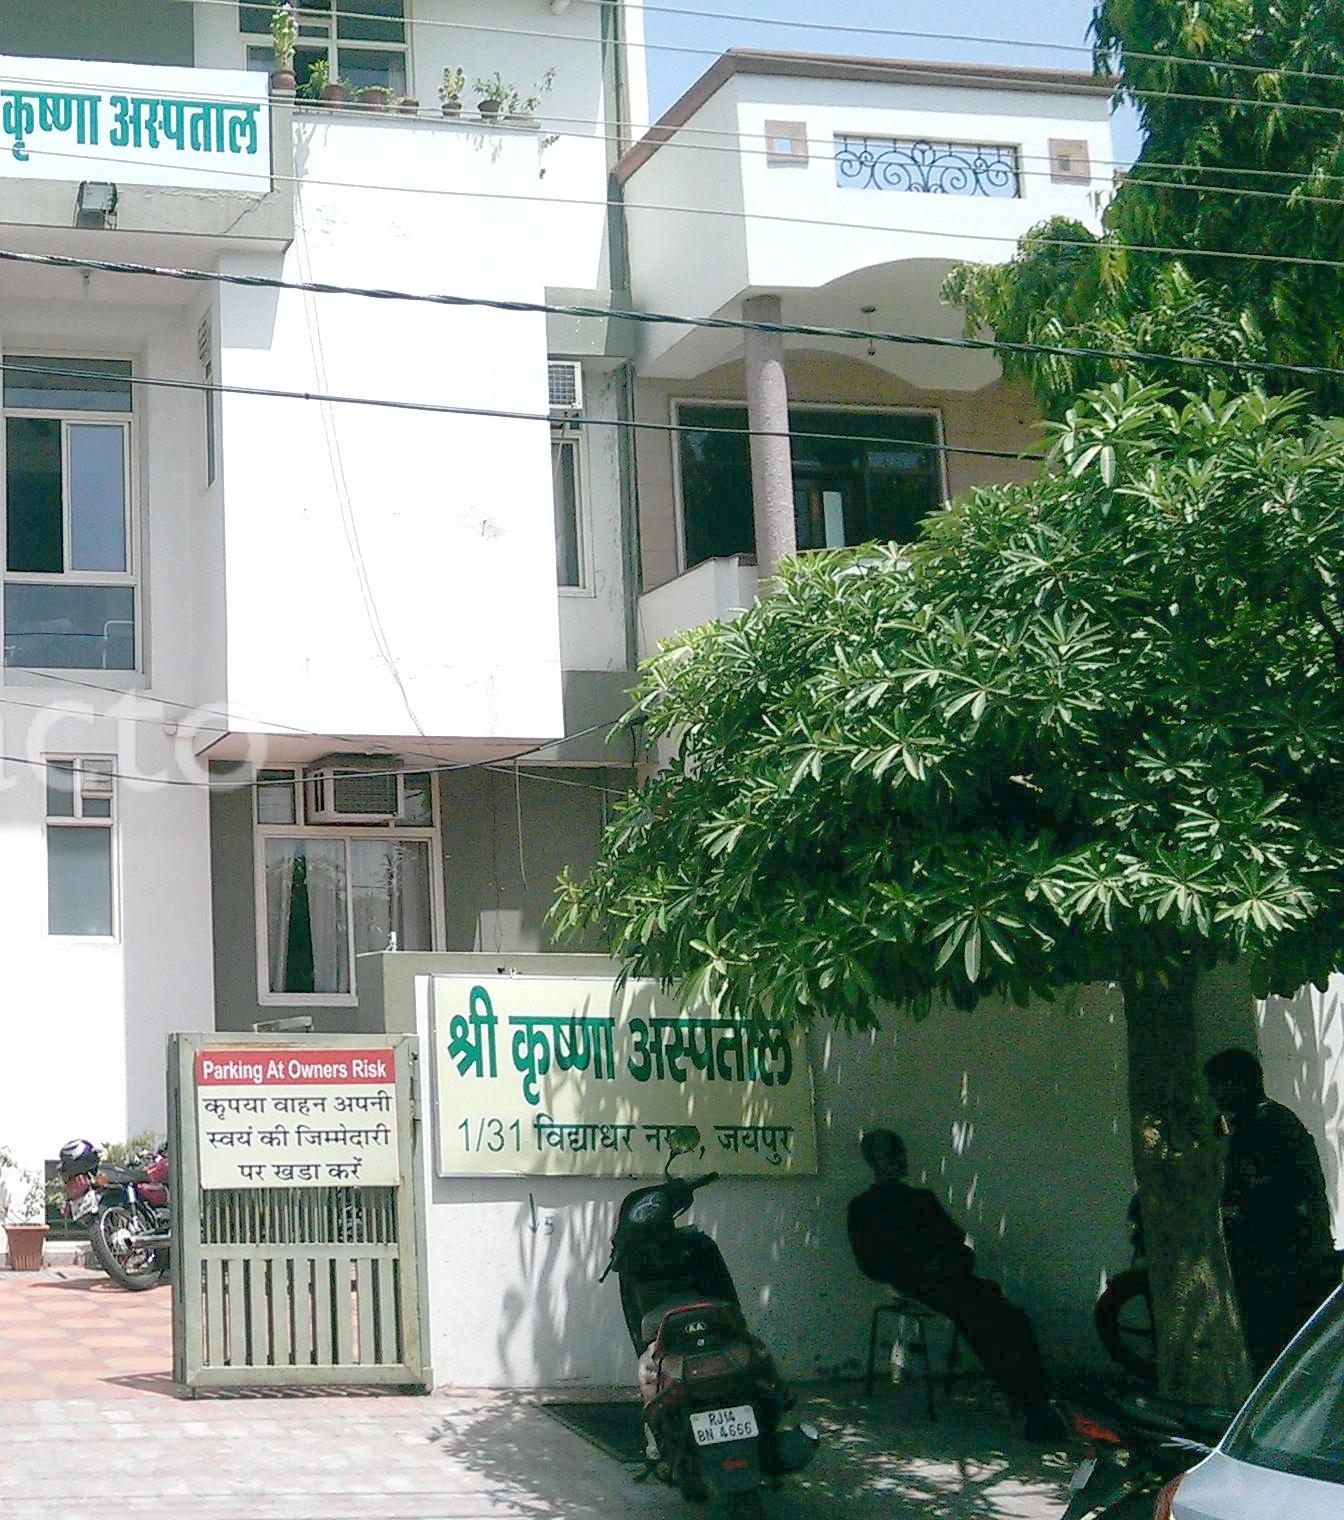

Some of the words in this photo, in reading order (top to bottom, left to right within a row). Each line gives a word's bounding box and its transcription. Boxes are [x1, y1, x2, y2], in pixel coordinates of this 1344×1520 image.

[0, 88, 102, 162] कृष्णा
[109, 95, 261, 155] अस्पताल
[446, 985, 499, 1079] श्री
[508, 1015, 615, 1106] कृष्णा
[627, 1015, 794, 1087] अस्पताल
[203, 1061, 263, 1084] Parking
[267, 1061, 285, 1079] At
[288, 1060, 348, 1078] Owners
[352, 1059, 387, 1078] Risk
[202, 1097, 267, 1121] कृपया
[272, 1097, 327, 1117] वाहन
[333, 1090, 393, 1113] अपनी
[206, 1125, 253, 1148] स्वयं
[257, 1124, 289, 1148] की
[294, 1123, 391, 1148] जिम्मेदारी
[457, 1117, 523, 1153] 1/31
[534, 1112, 636, 1153] विद्याधर
[713, 1125, 794, 1165] जयपुर
[237, 1163, 267, 1182] पर
[326, 1157, 363, 1181] करें
[708, 1411, 736, 1425] RJ14
[698, 1427, 714, 1441] BN
[720, 1422, 752, 1438] 4666
